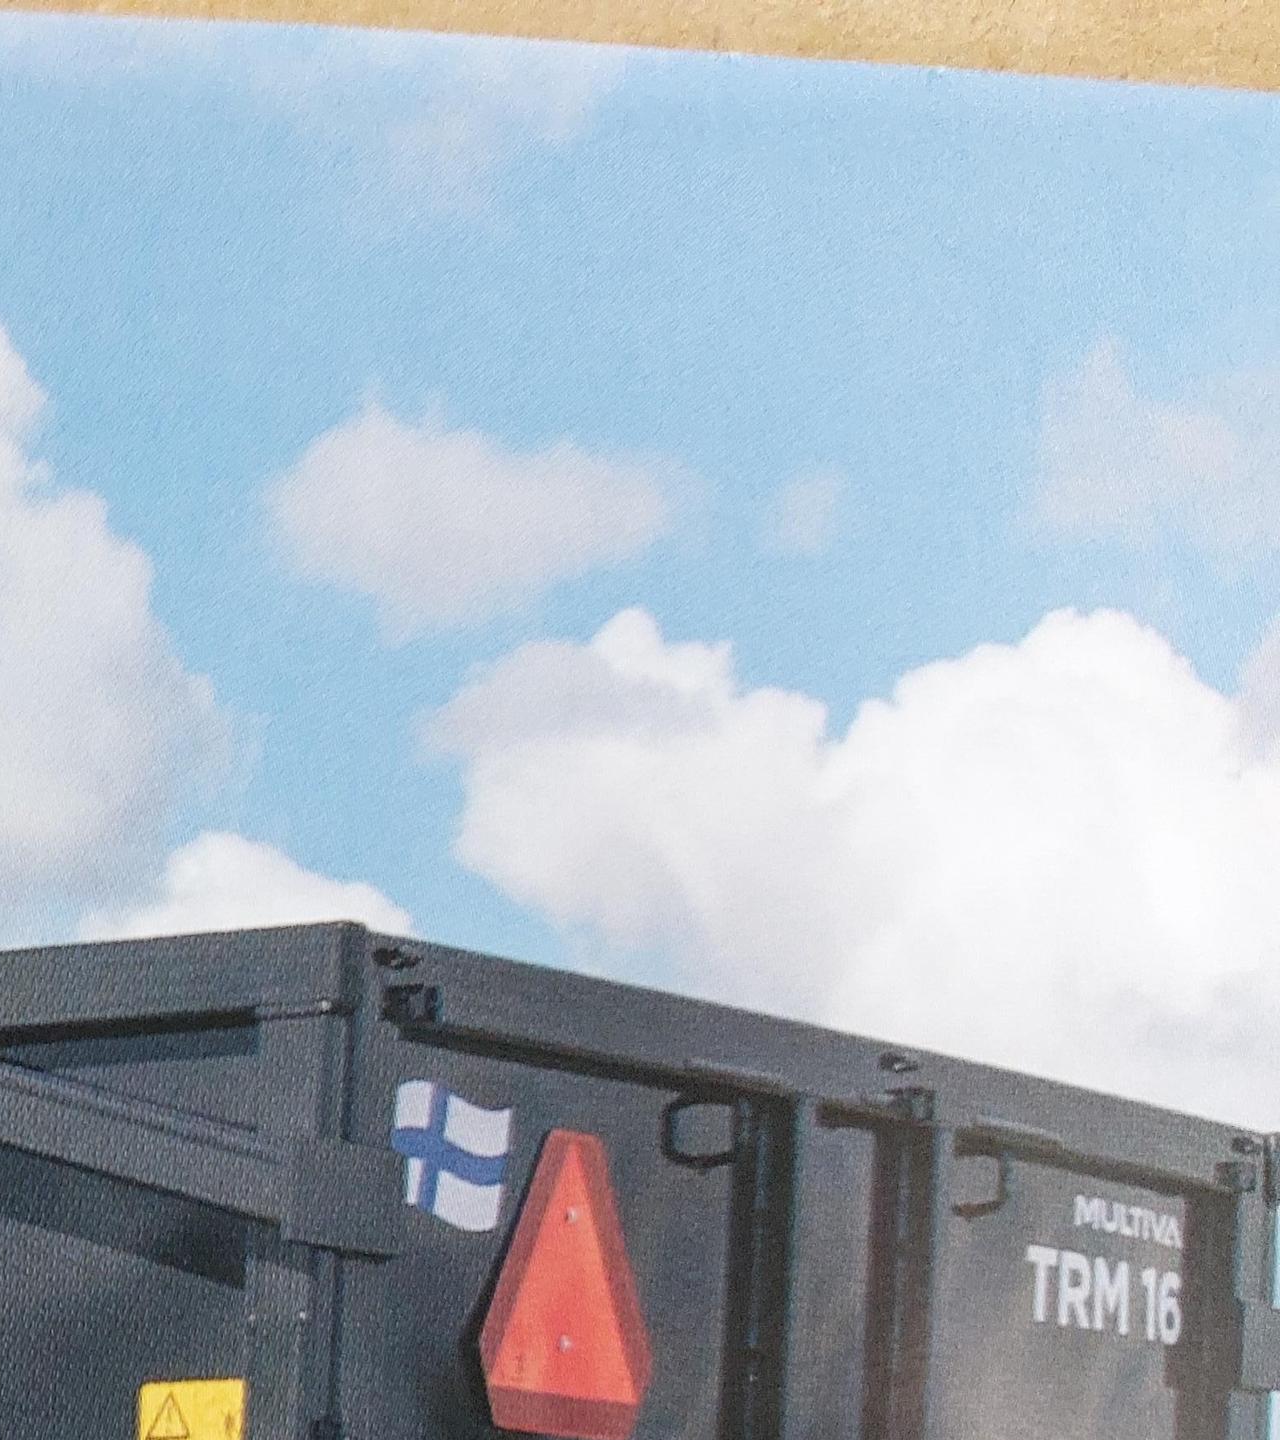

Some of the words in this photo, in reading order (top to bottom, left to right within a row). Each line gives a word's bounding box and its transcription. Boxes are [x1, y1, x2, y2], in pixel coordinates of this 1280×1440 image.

[1073, 1195, 1184, 1249] MULTIVA
[1026, 1245, 1130, 1336] TRM
[1142, 1267, 1182, 1345] 16
